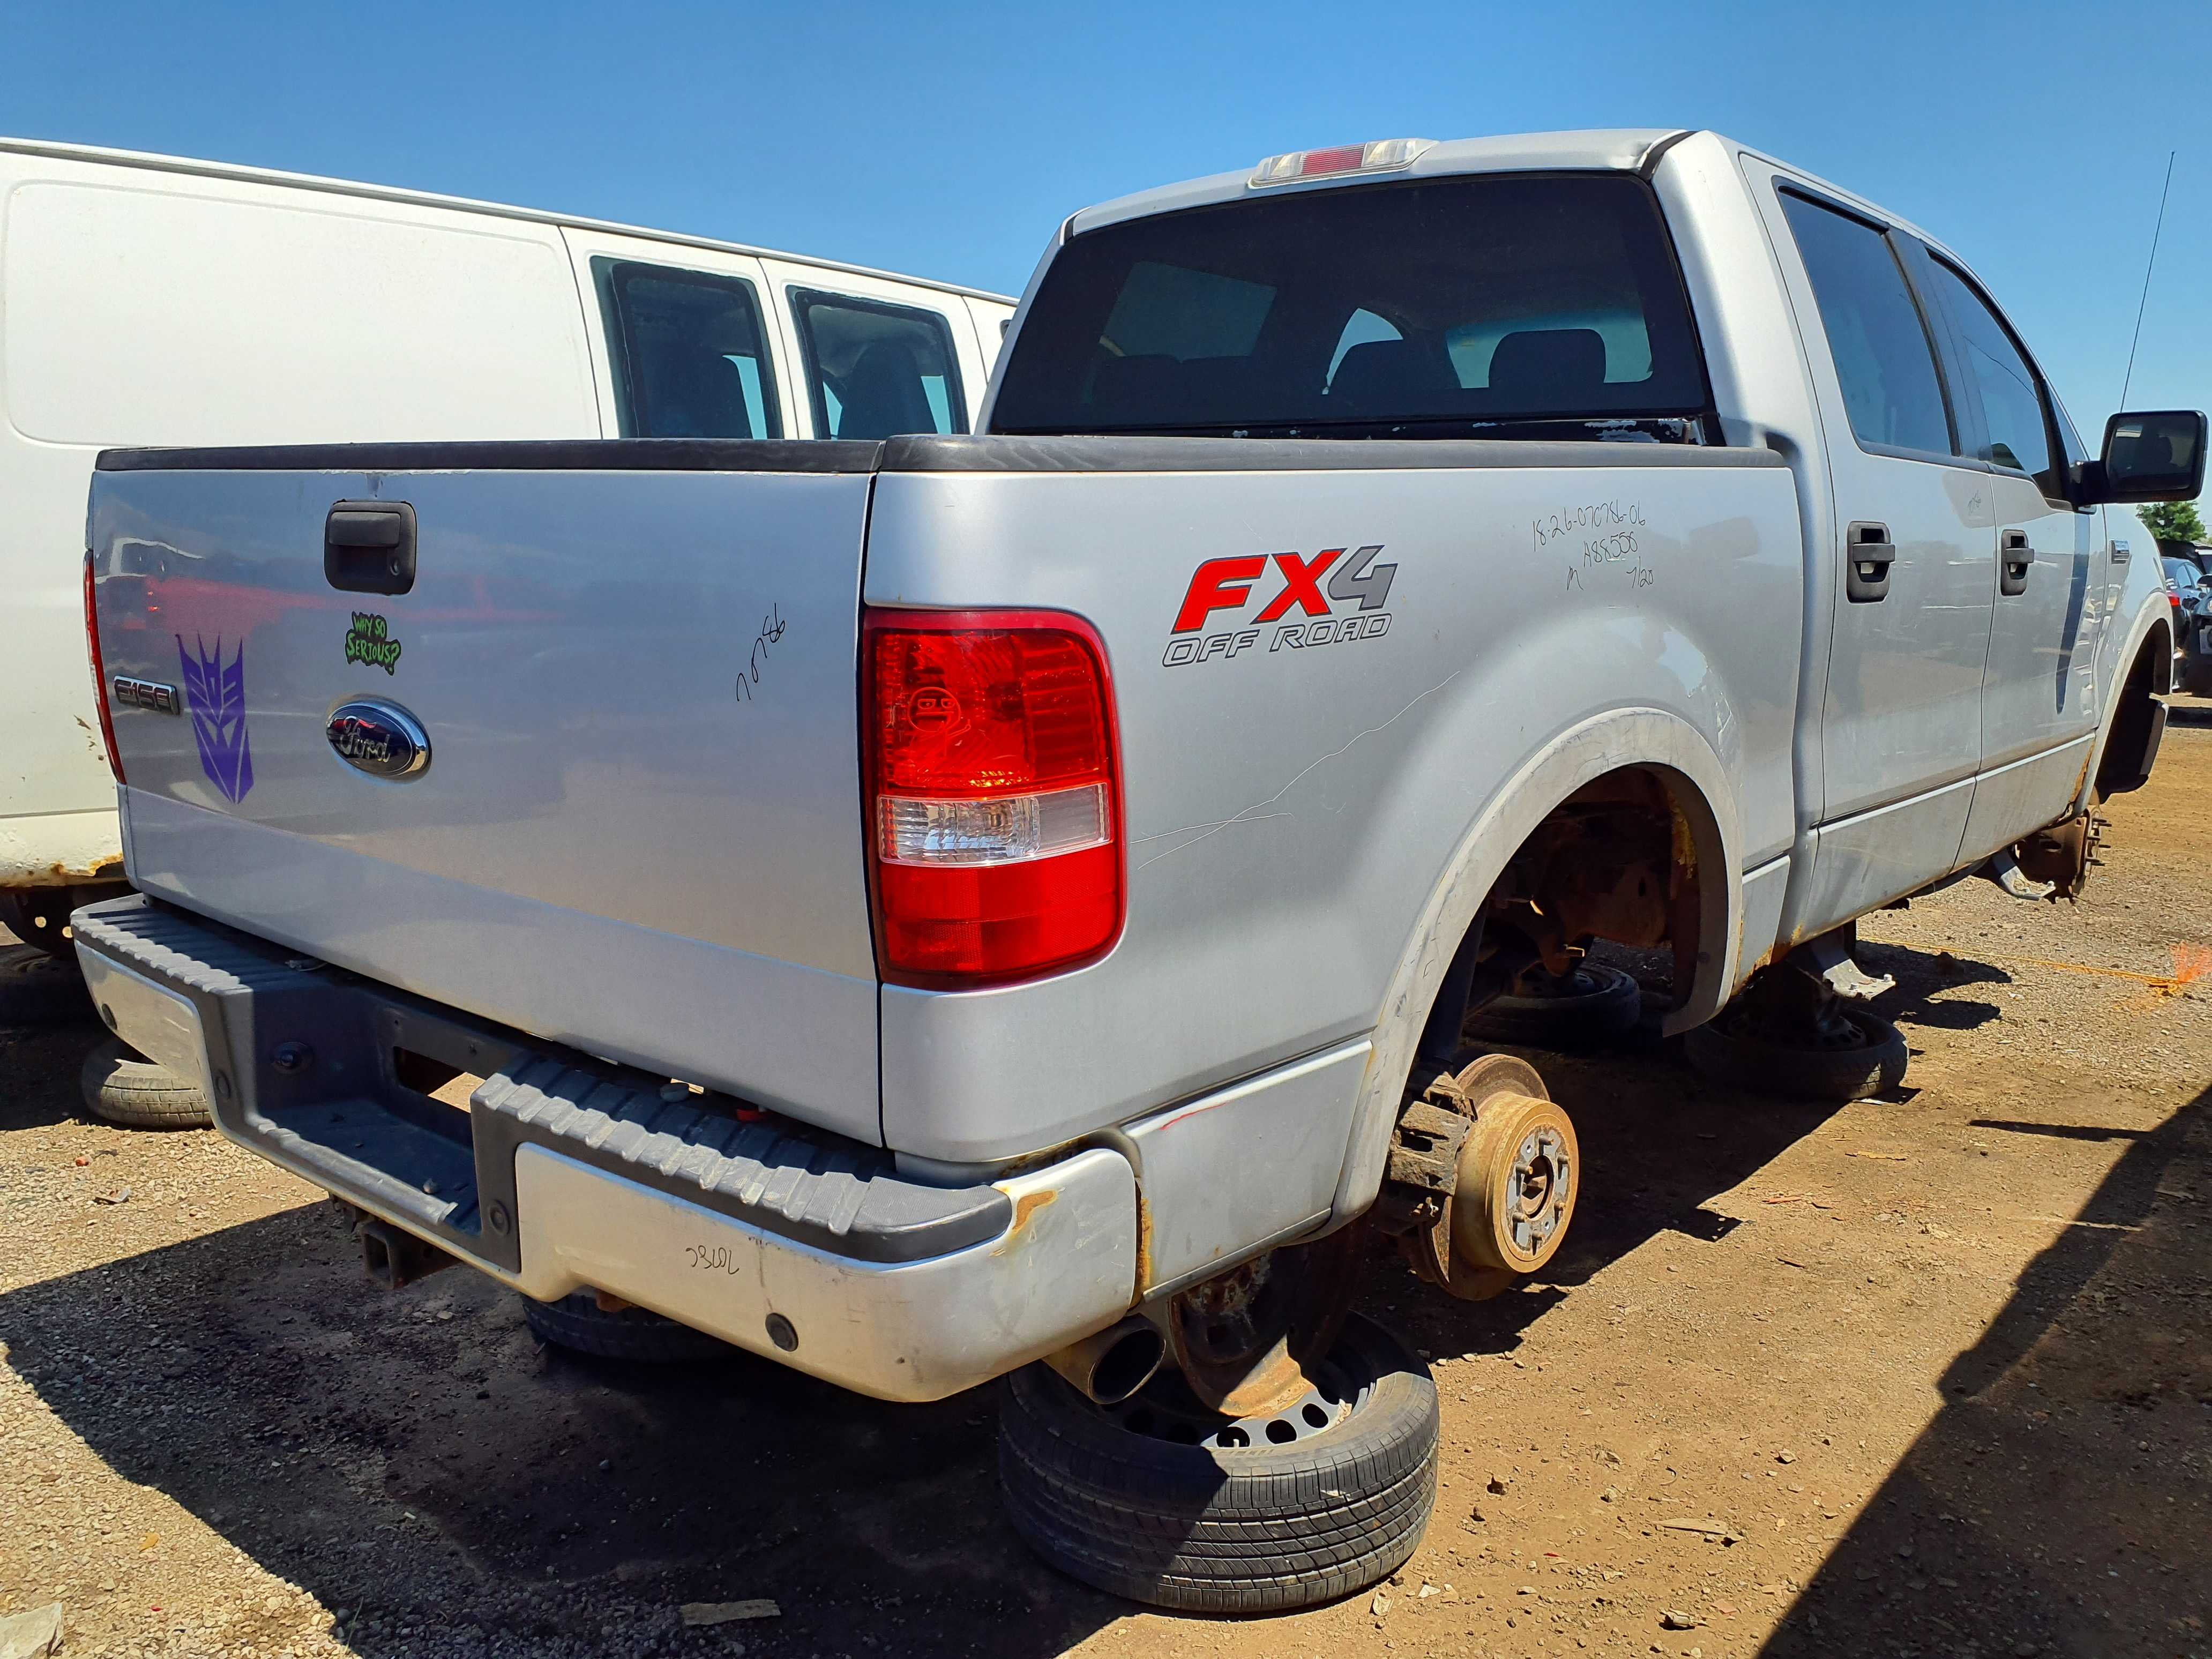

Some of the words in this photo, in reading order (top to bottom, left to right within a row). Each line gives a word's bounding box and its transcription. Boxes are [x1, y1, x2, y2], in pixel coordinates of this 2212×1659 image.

[1171, 545, 1398, 635] FX4
[353, 615, 373, 638] WHY
[375, 618, 386, 638] SO
[1162, 629, 1260, 668] OFF
[1269, 613, 1392, 653] ROAD
[346, 632, 400, 672] SERIOUS?
[338, 715, 391, 764] Ford
